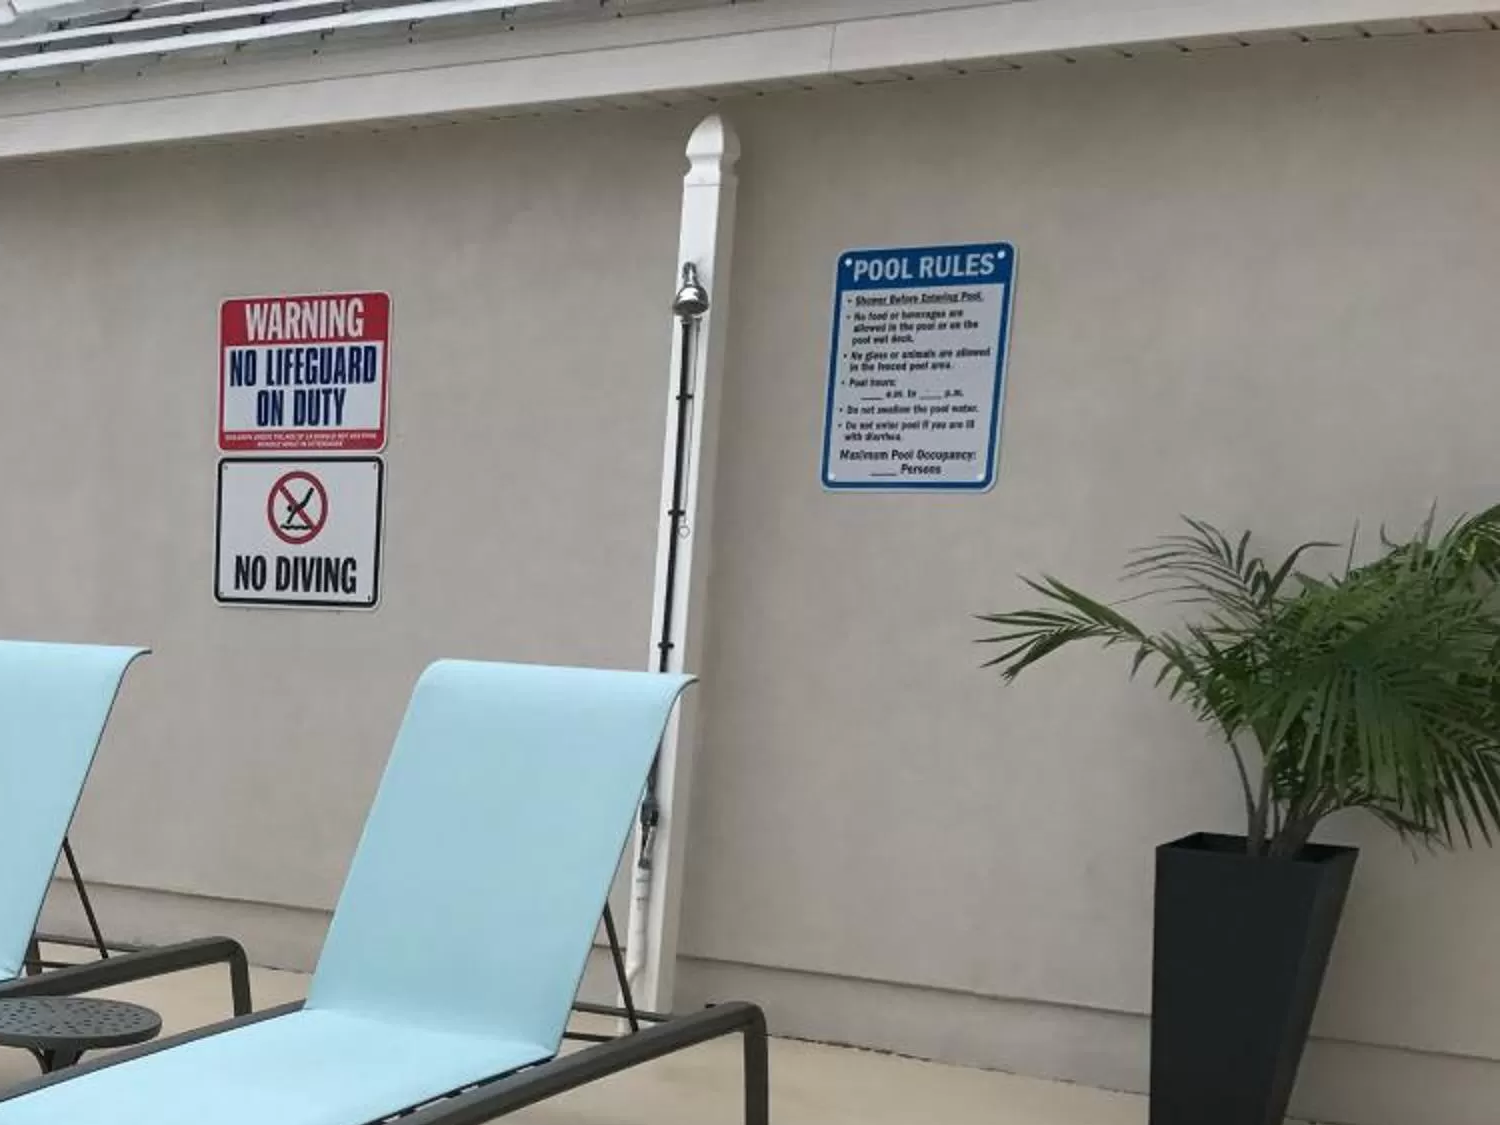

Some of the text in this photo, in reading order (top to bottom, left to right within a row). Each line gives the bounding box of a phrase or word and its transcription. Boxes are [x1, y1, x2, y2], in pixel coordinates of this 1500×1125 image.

[853, 252, 995, 282] POOL RULES
[245, 297, 366, 342] WARNING
[854, 309, 964, 321] No food or beverages are
[853, 323, 886, 333] allowed
[900, 321, 914, 331] the
[915, 321, 936, 334] pool
[963, 319, 979, 329] the
[852, 334, 871, 347] pool
[851, 345, 991, 362] No glass or animals are allowed
[229, 344, 378, 388] NO LIFEGUARD
[861, 361, 875, 371] the
[909, 360, 929, 373] pool
[848, 377, 869, 388] Pool
[255, 387, 347, 428] ON DUTY
[846, 404, 859, 415] Do
[861, 405, 875, 415] not
[913, 403, 928, 415] the
[929, 403, 949, 417] pool
[845, 420, 857, 431] Do
[860, 421, 874, 431] not
[901, 420, 921, 432] pool
[930, 421, 947, 433] you
[949, 421, 964, 431] are
[844, 431, 863, 442] with
[839, 448, 977, 464] Maximum Pool Occupancy:
[900, 462, 942, 475] Persons
[233, 555, 358, 595] NO DIVING
